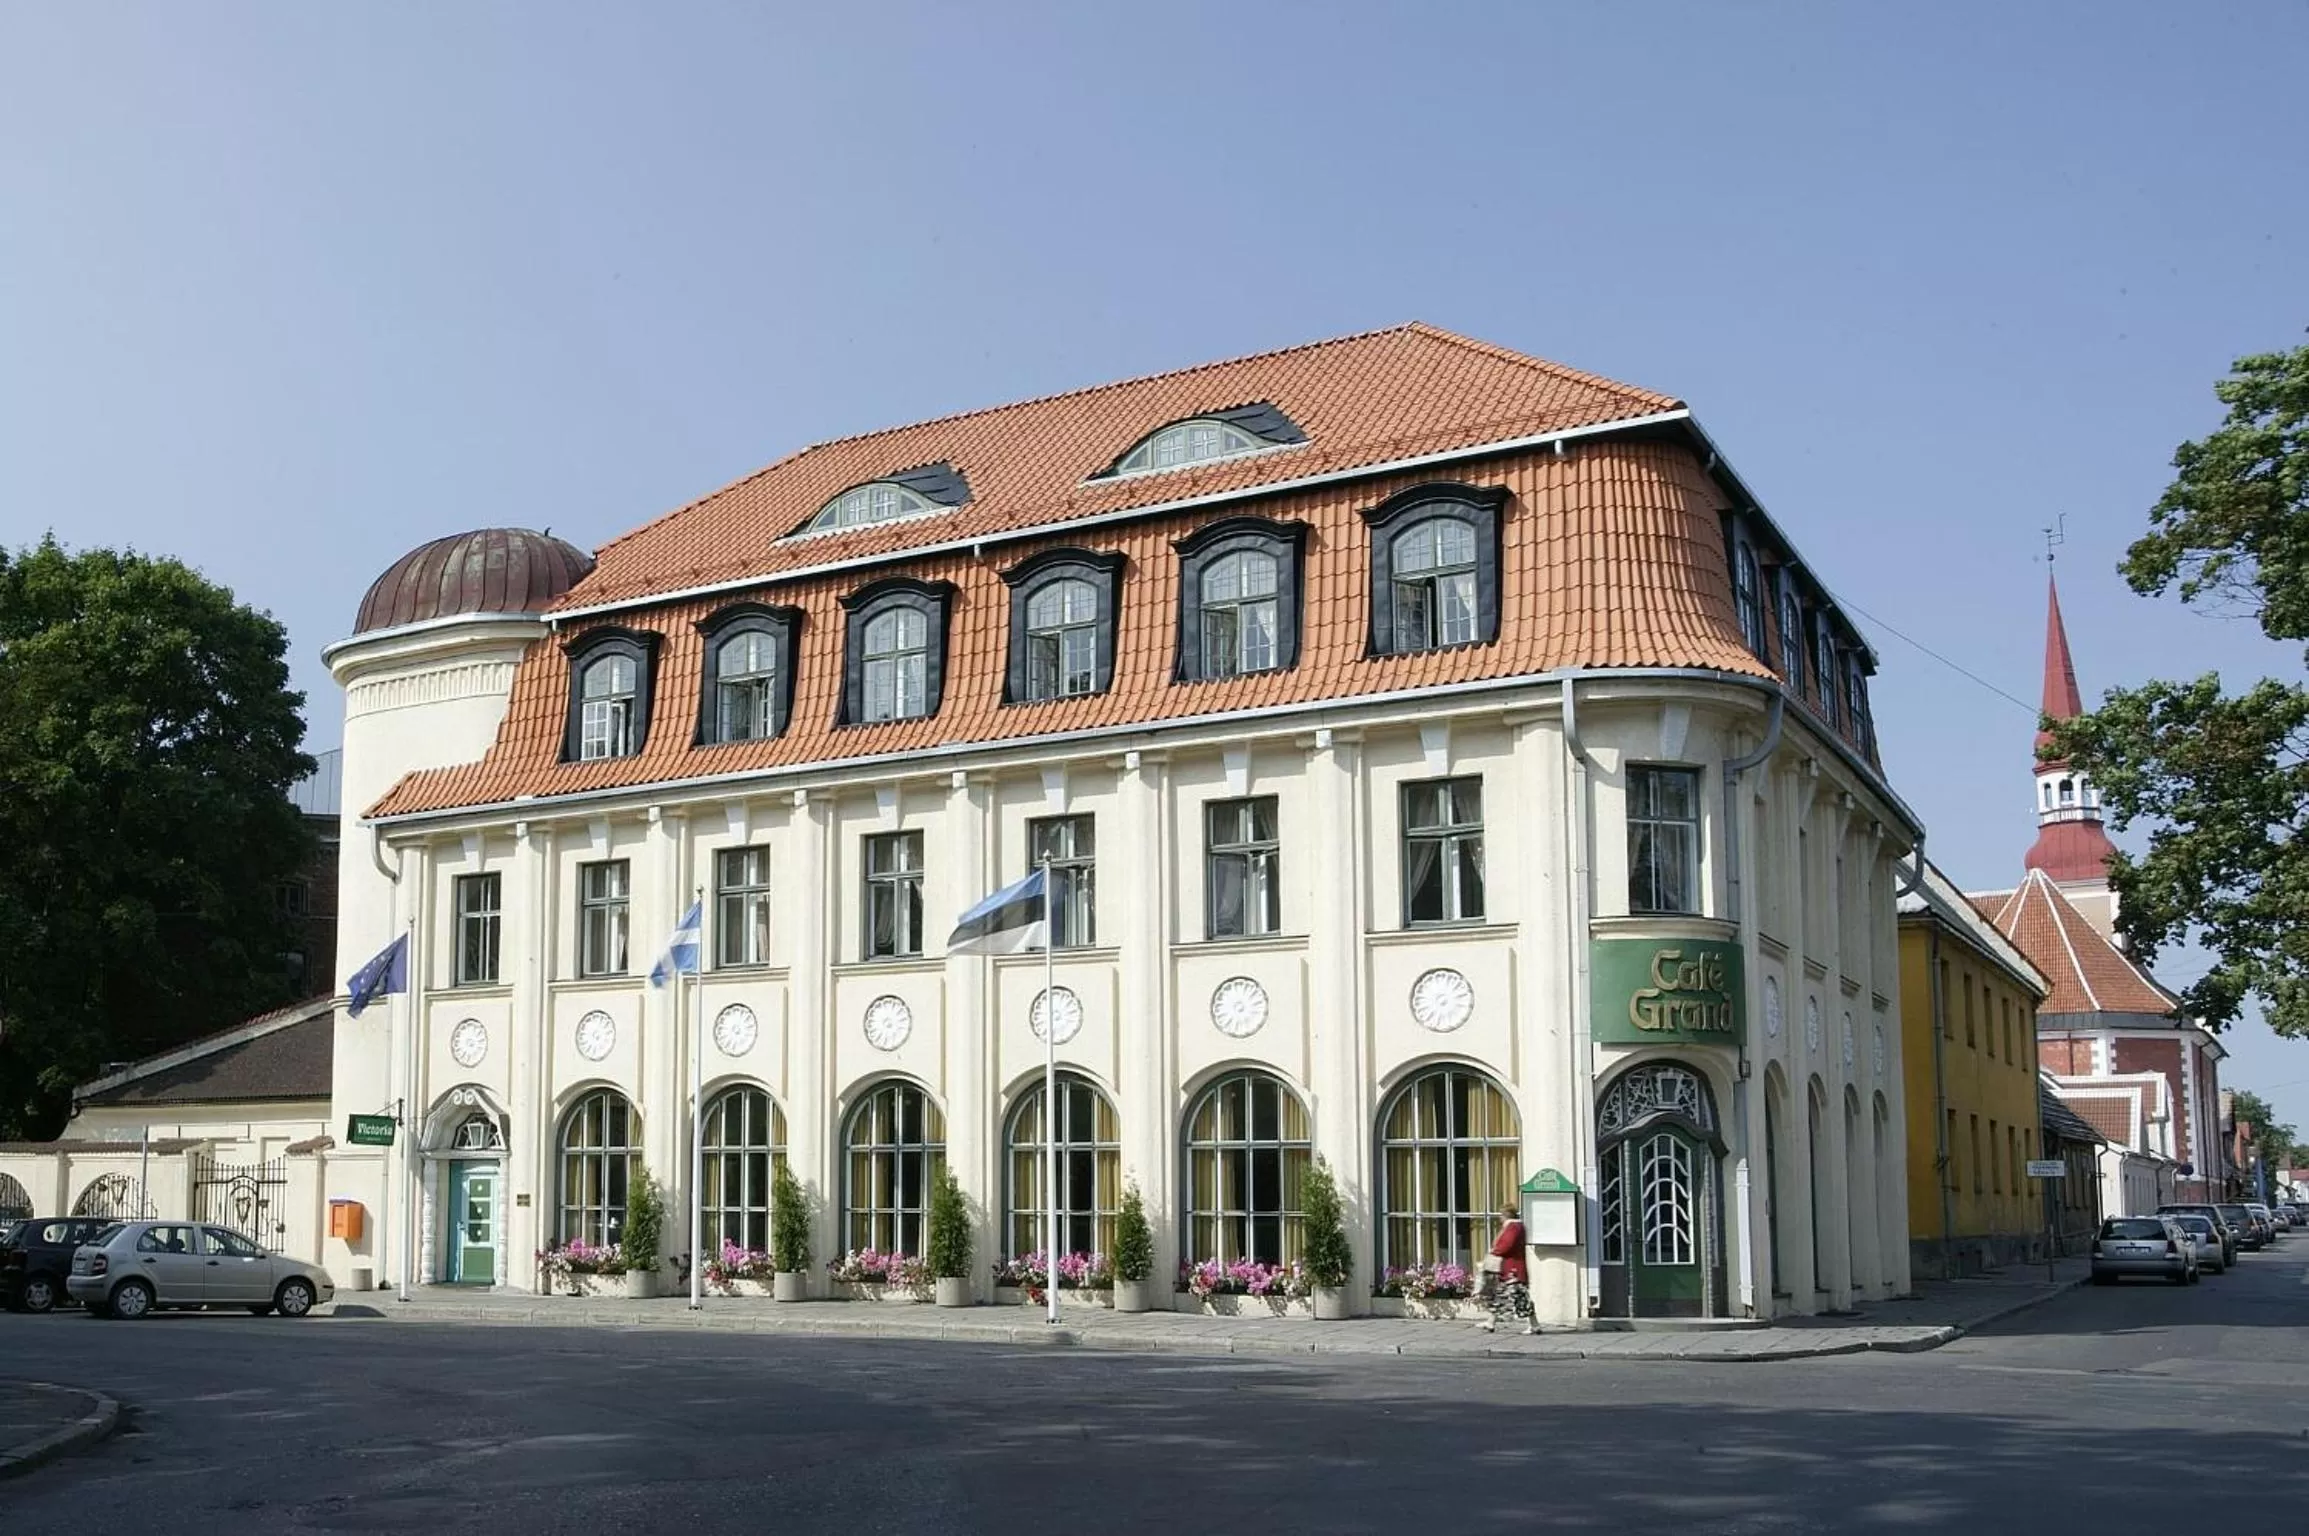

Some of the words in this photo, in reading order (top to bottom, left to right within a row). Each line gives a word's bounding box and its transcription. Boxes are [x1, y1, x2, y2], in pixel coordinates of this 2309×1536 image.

[1651, 949, 1724, 992] Café
[1629, 987, 1734, 1032] Grand
[358, 1122, 393, 1136] Victoria
